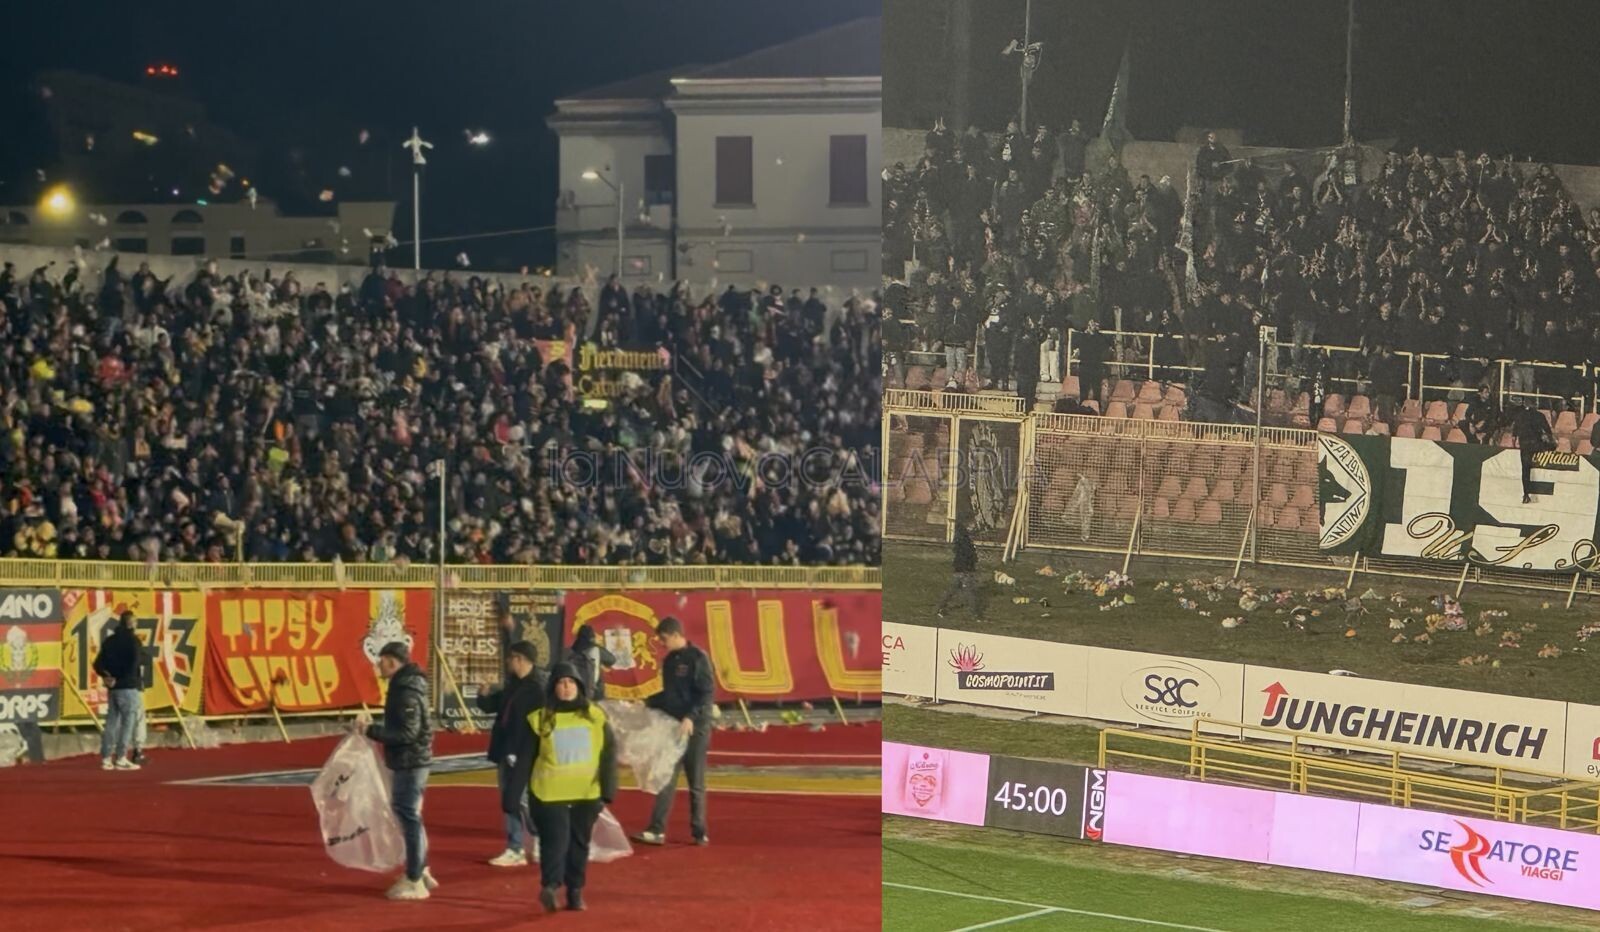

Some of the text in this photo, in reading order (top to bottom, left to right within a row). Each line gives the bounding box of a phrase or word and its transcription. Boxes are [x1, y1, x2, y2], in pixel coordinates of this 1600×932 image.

[220, 598, 333, 652] TIPSY
[456, 619, 486, 636] THE
[443, 637, 498, 656] EAGLES
[1144, 674, 1199, 708] S&C
[1261, 698, 1548, 760] JUNGHEINRICH
[994, 781, 1068, 816] 45:00
[1521, 865, 1563, 881] VIAGGI
